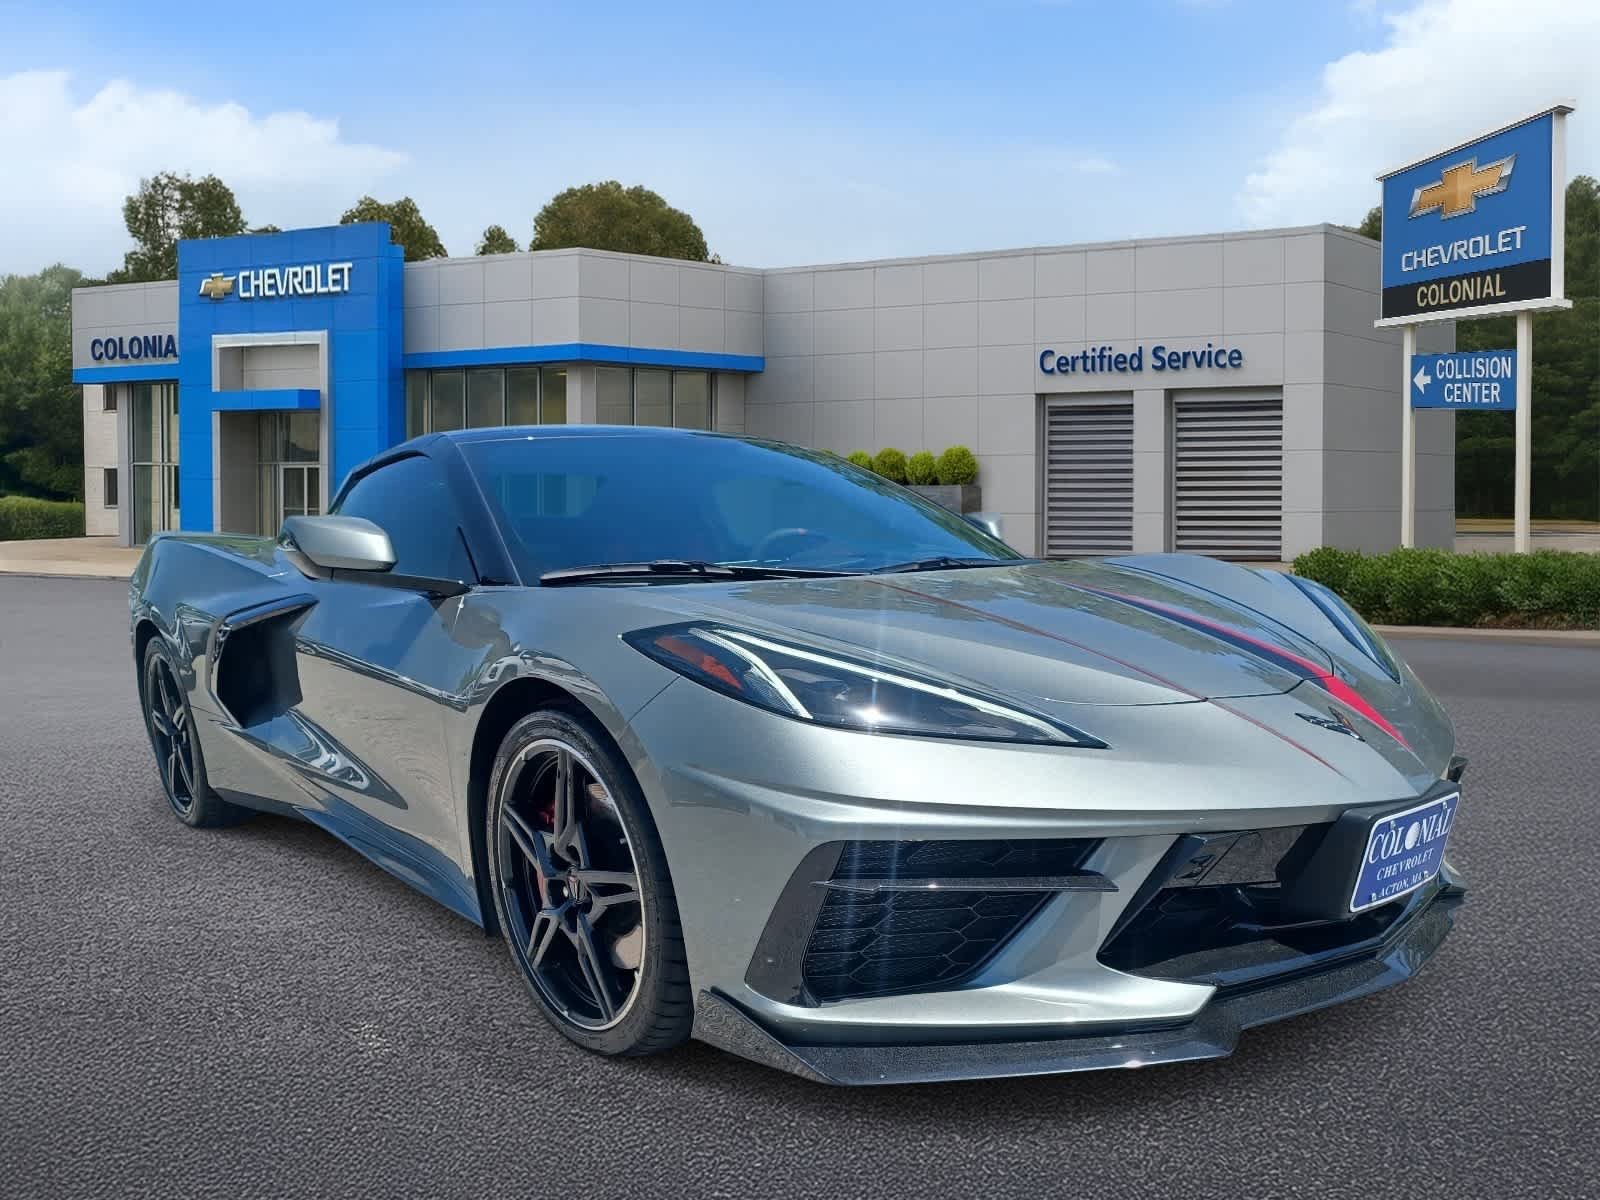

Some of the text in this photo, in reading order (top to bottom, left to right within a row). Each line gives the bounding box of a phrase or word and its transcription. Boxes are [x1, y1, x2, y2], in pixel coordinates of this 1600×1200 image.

[1401, 225, 1527, 272] CHEVROLET
[238, 262, 352, 298] CHEVROLET
[1417, 274, 1506, 307] COLONIAL
[1040, 343, 1243, 374] Certified Service
[1436, 356, 1512, 379] COLLISION
[1444, 382, 1501, 402] CENTER
[1368, 807, 1452, 864] COLONIAL
[1376, 847, 1435, 881] CHEVROLET
[1379, 878, 1409, 897] ACTON,
